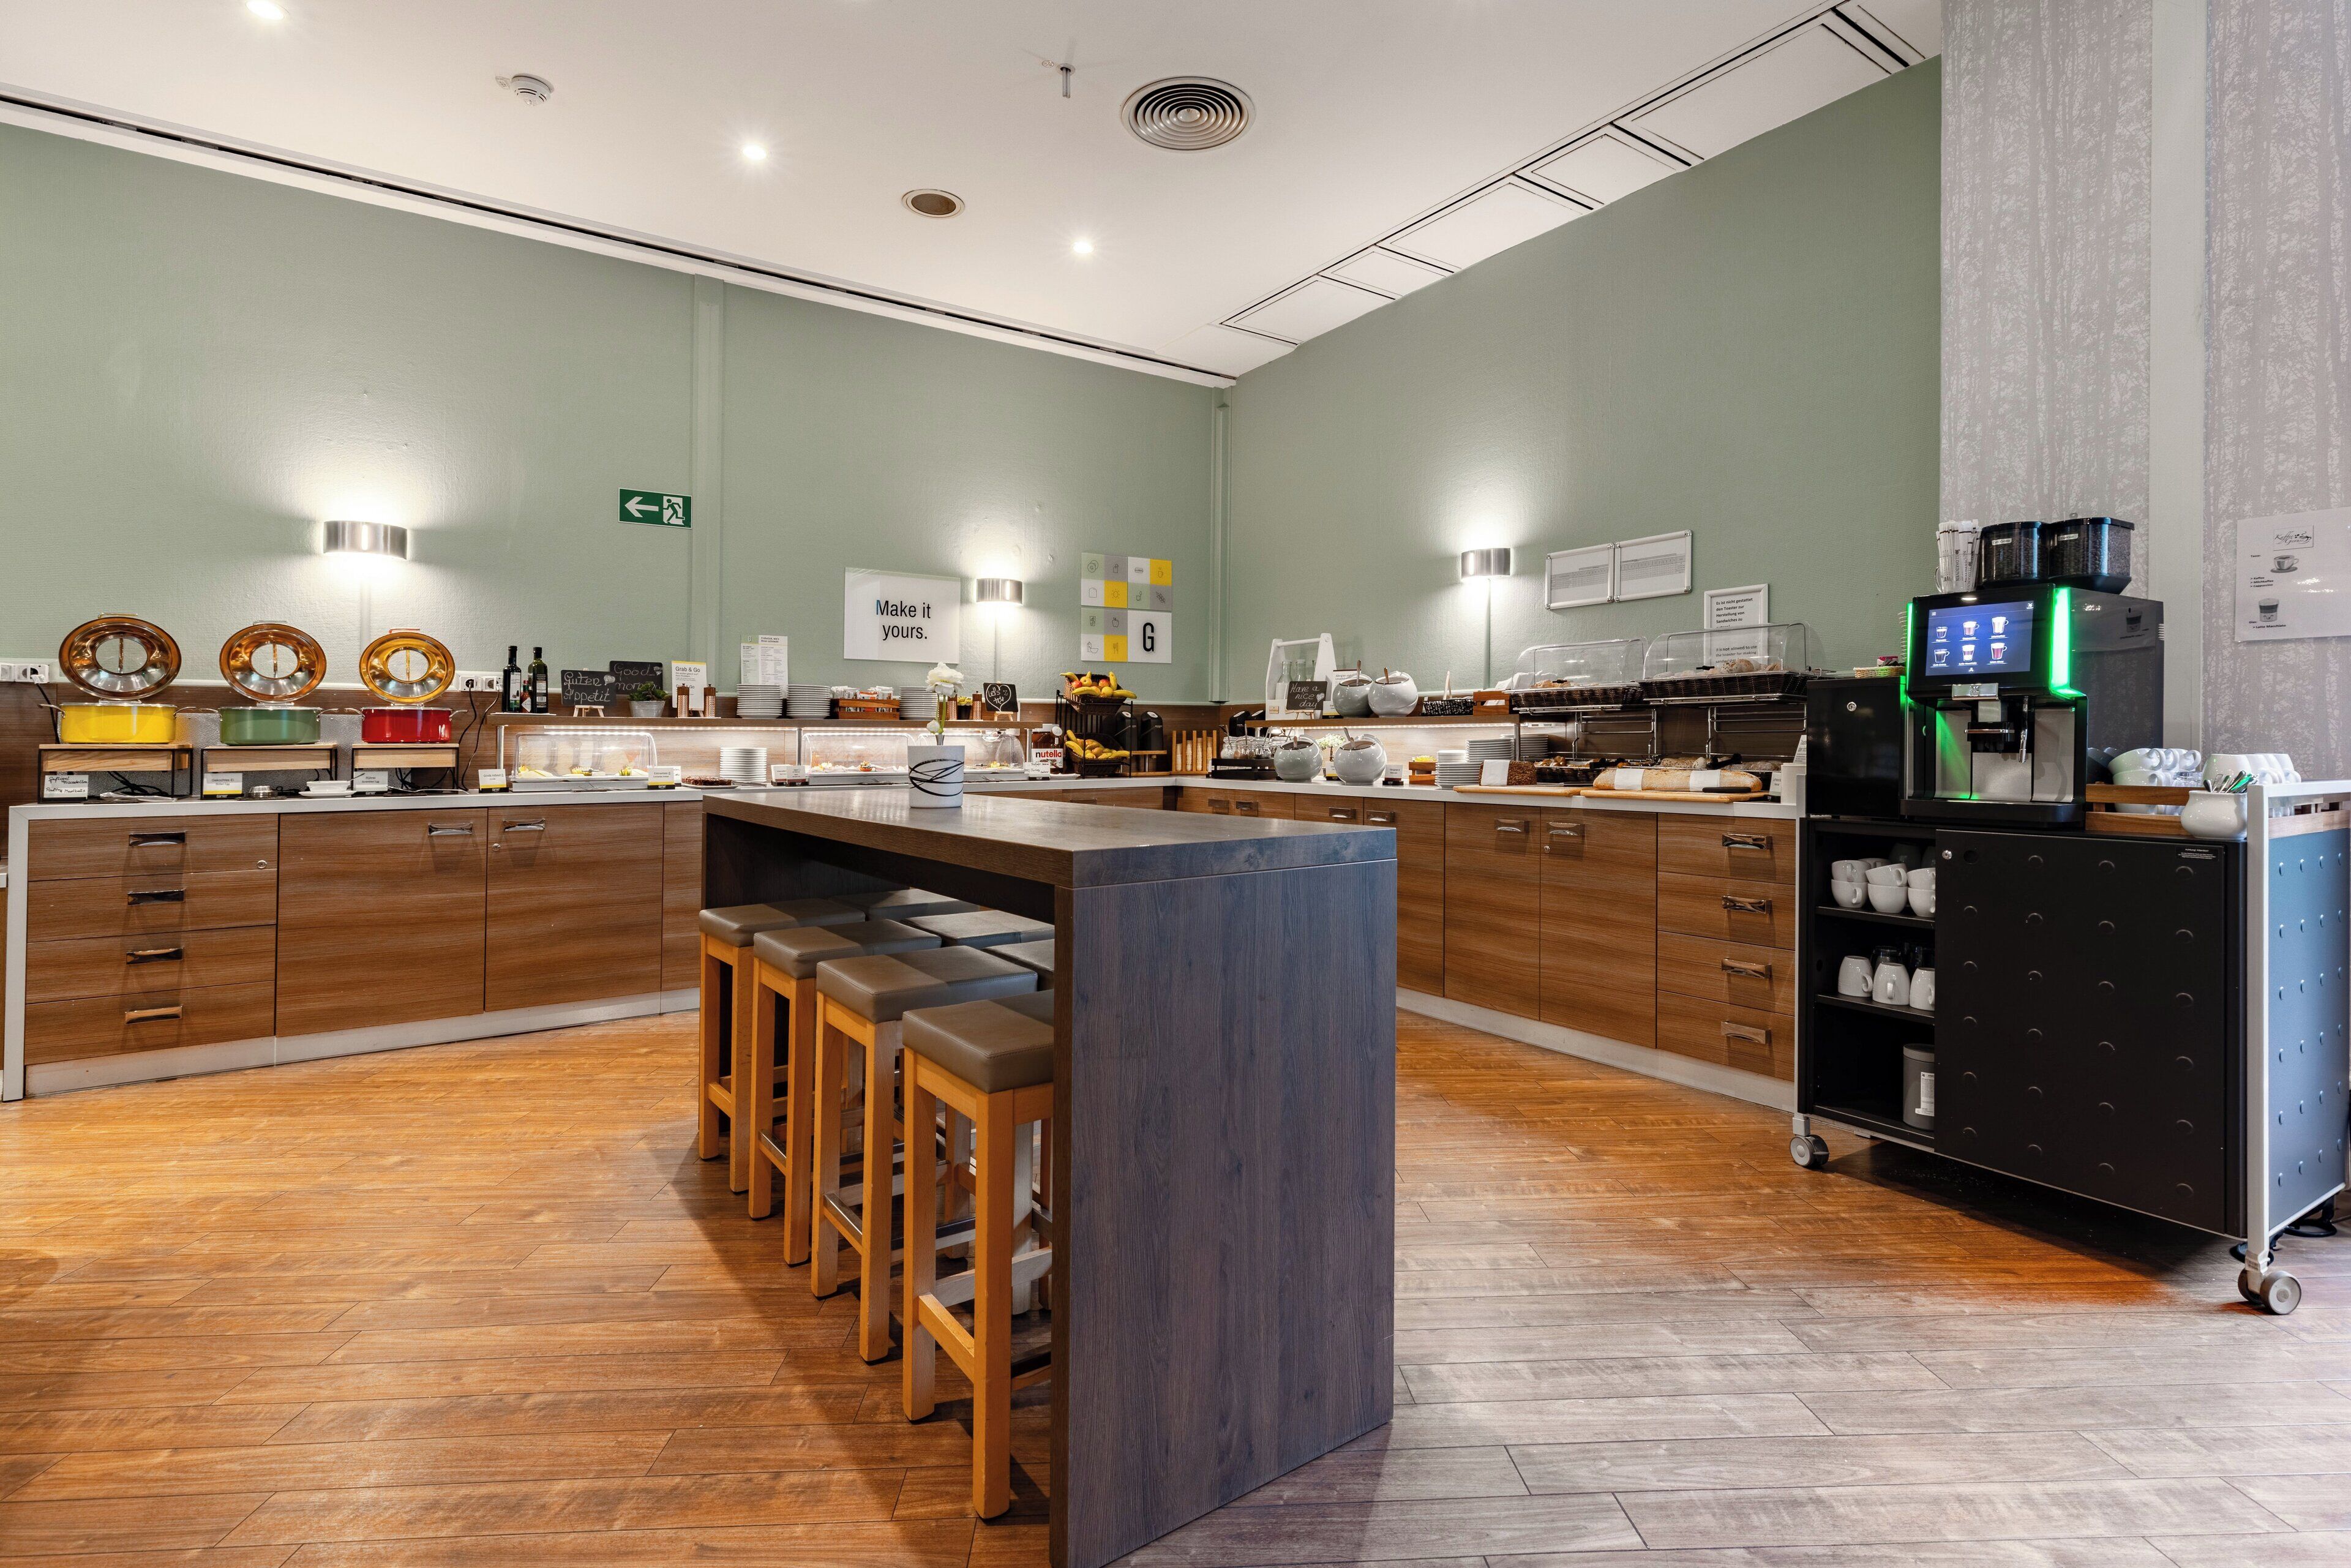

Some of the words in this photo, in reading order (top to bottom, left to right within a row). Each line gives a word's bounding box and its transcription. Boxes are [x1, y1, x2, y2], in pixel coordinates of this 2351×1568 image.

[876, 599, 917, 618] Make
[923, 602, 931, 618] it
[882, 625, 928, 641] yours.
[1142, 622, 1155, 652] G
[614, 663, 654, 681] Good
[564, 672, 602, 689] Guten
[1289, 683, 1310, 694] Have
[993, 696, 1004, 705] try
[1299, 699, 1318, 710] day
[1035, 749, 1062, 758] nutella
